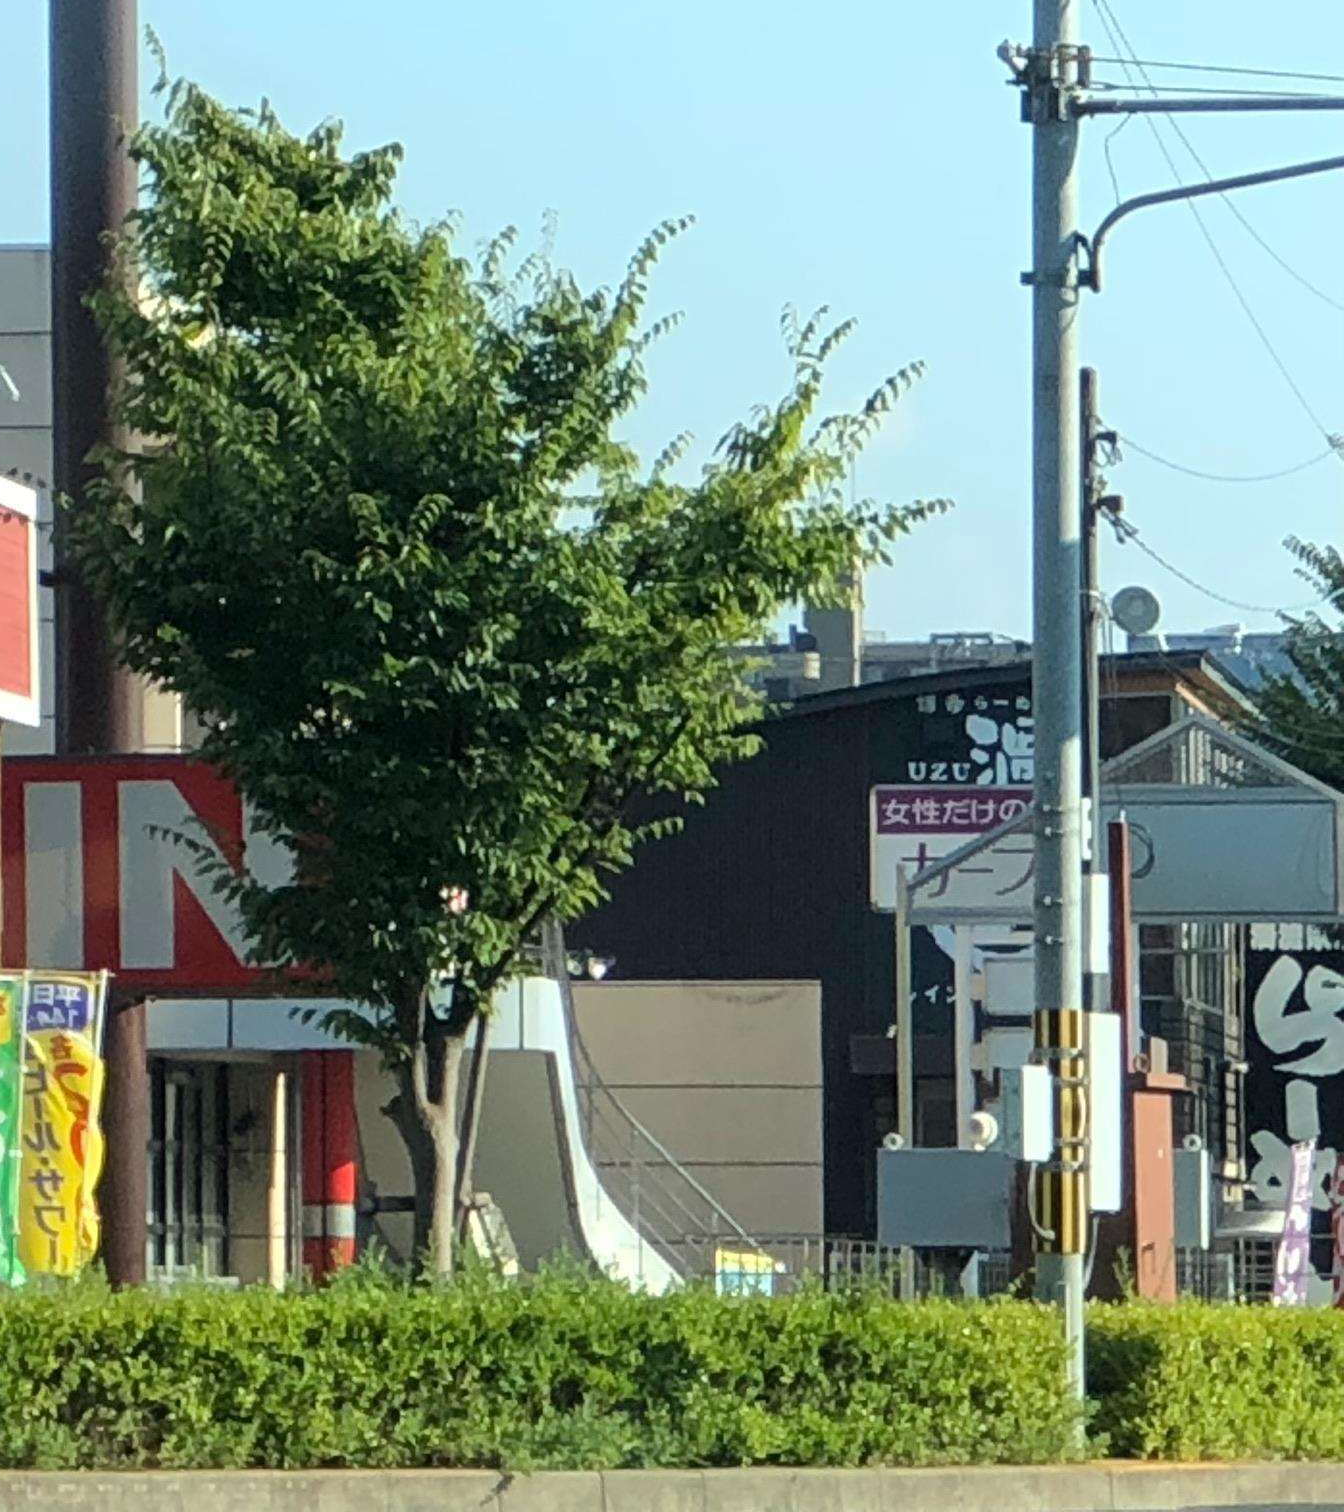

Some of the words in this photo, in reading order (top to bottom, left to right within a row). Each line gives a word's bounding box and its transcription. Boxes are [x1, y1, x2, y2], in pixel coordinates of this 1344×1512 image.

[908, 761, 971, 781] UZU
[882, 797, 1035, 826] 女性だけの
